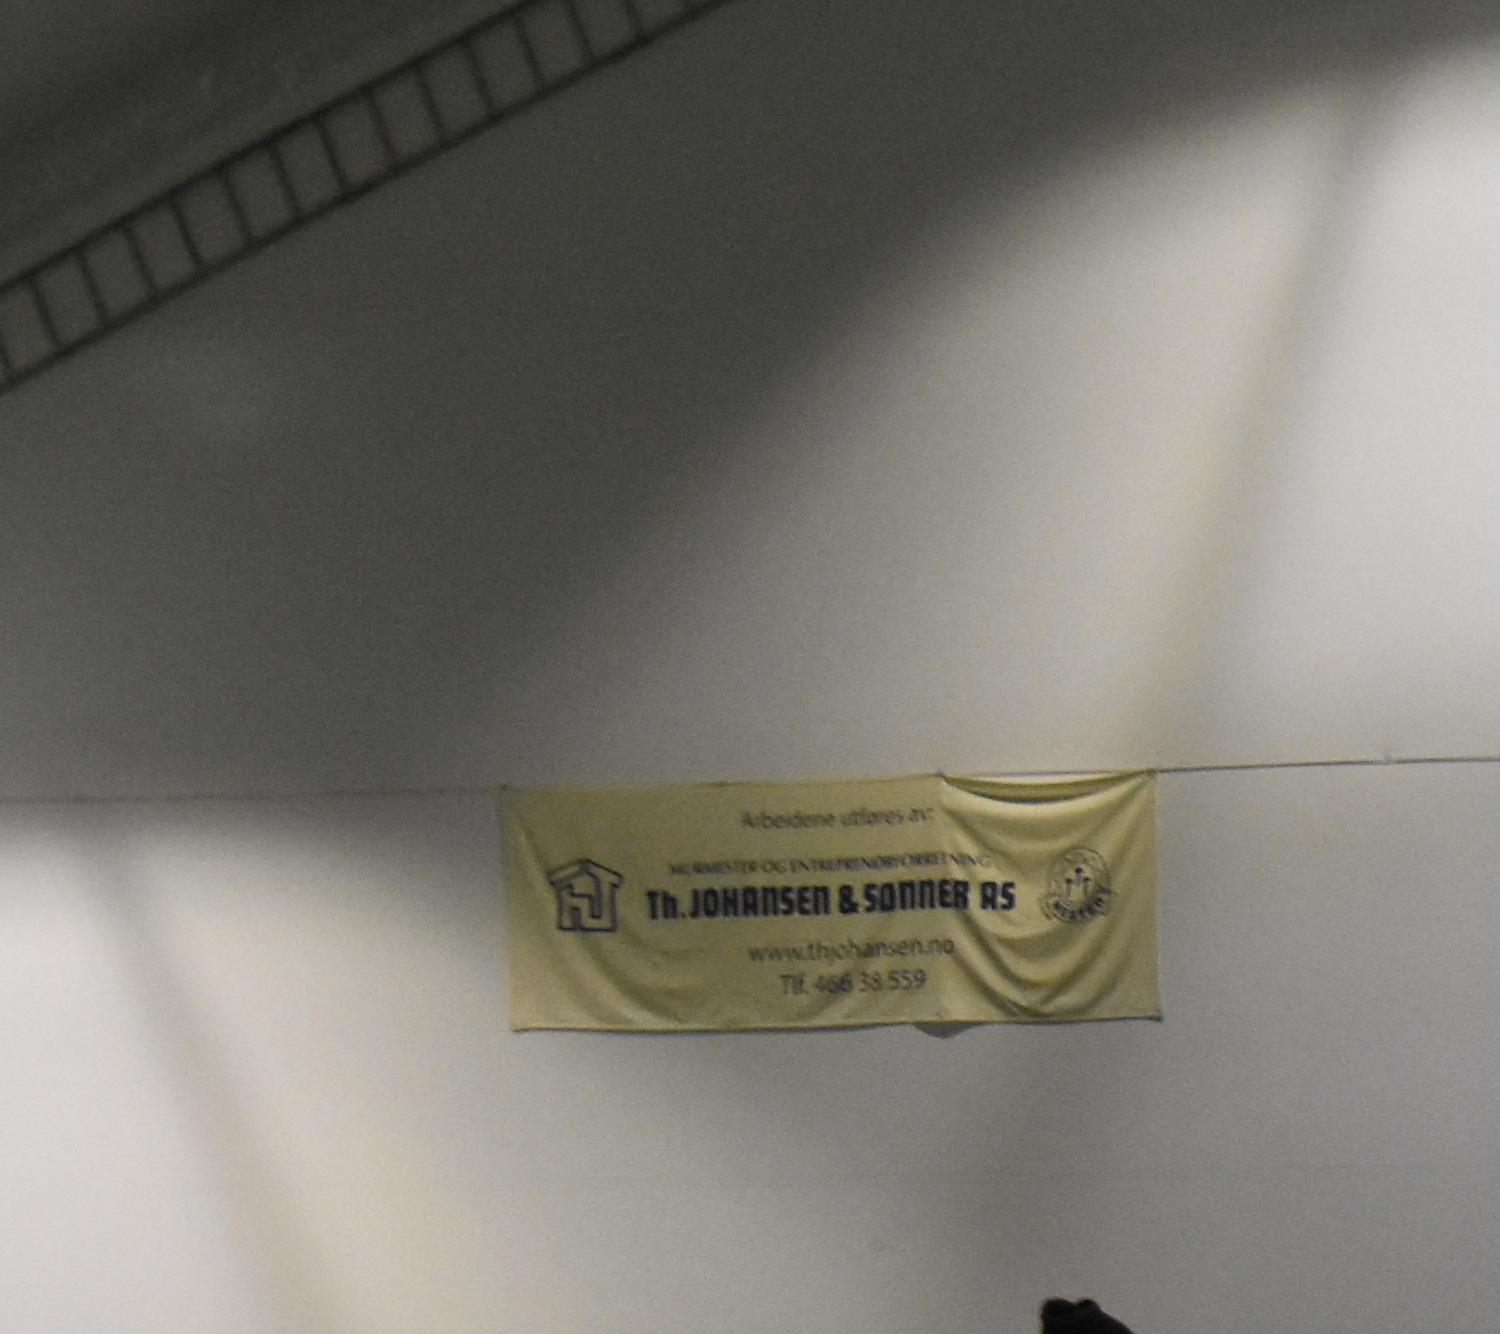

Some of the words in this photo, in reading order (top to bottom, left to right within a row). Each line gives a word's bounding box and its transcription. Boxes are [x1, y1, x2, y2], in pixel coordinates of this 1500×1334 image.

[691, 885, 832, 919] JOHANSEN
[838, 883, 860, 915] &
[980, 879, 1016, 911] AS
[748, 938, 955, 965] www.thjohansen.no
